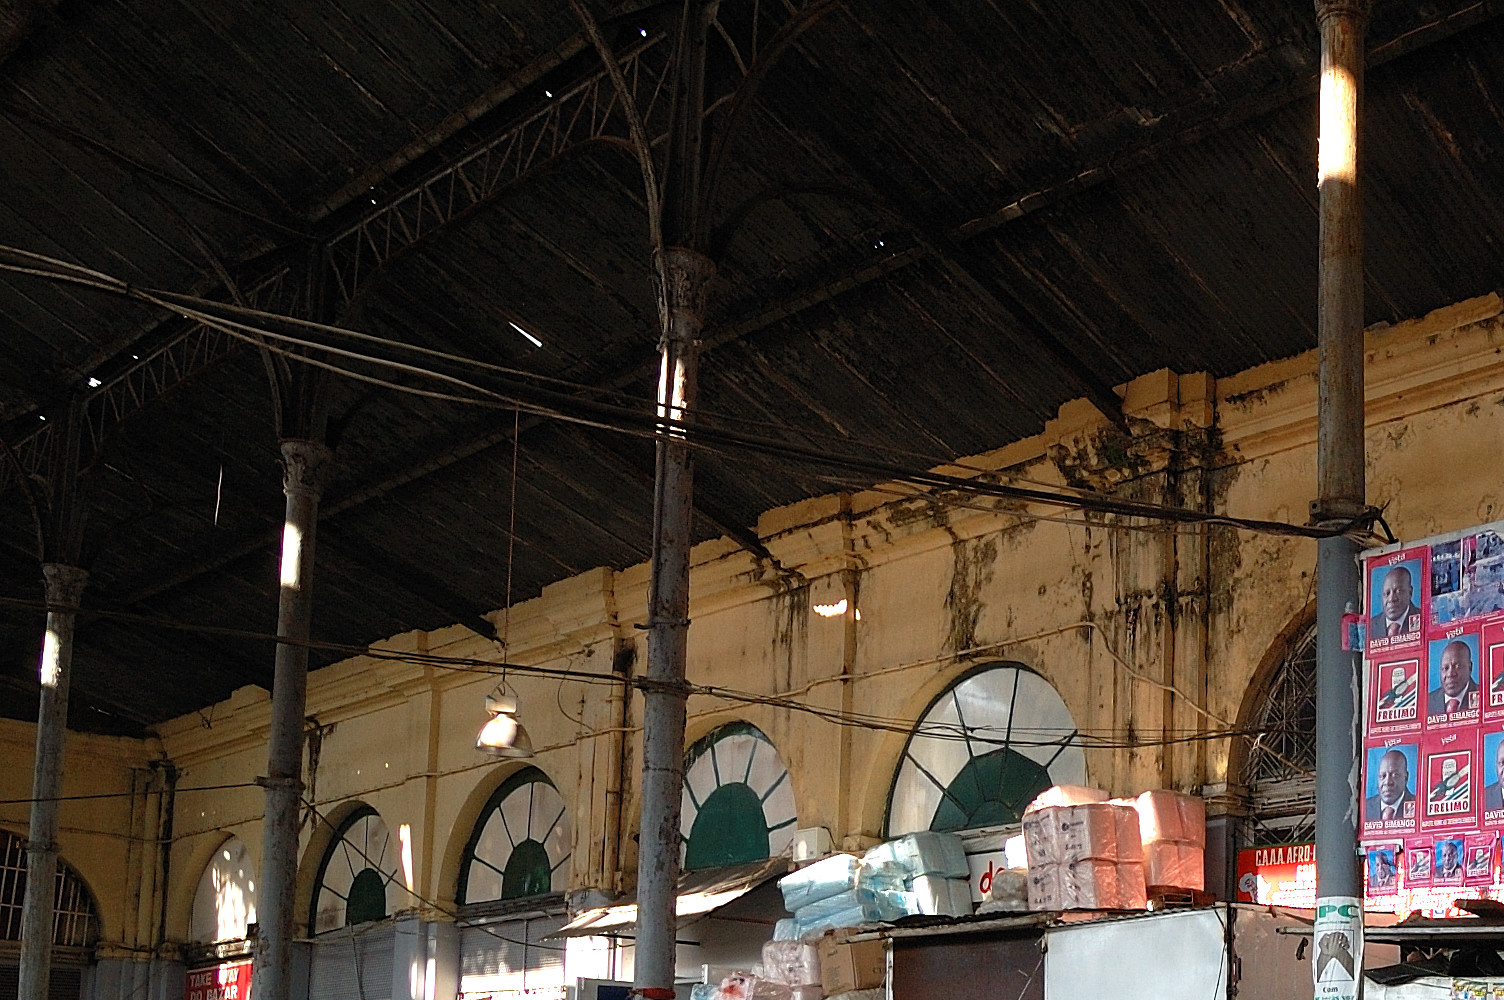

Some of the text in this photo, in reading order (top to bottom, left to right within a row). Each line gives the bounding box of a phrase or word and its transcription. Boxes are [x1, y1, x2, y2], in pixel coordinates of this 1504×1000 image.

[1377, 707, 1416, 721] FRELIMO
[1441, 733, 1456, 745] Vota
[1429, 800, 1469, 813] FRELIMO
[1315, 904, 1360, 919] PC
[190, 972, 212, 987] TAKE
